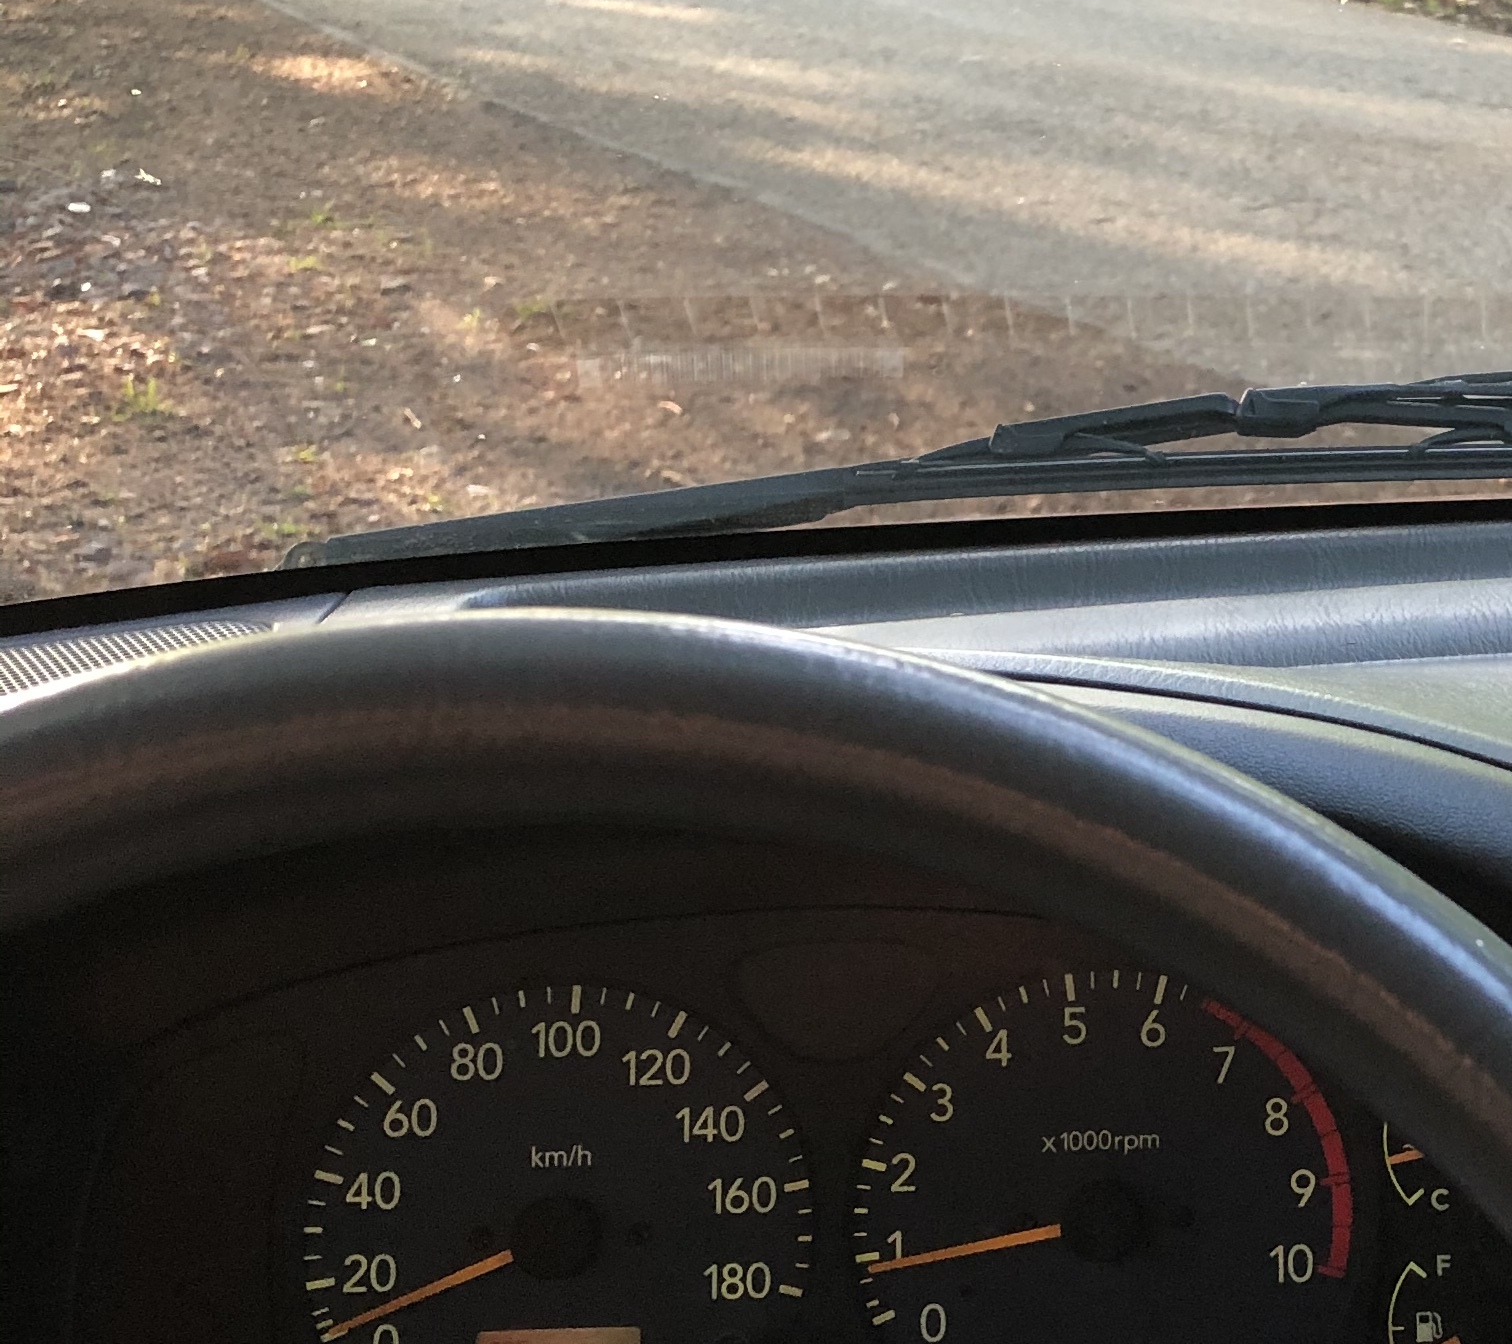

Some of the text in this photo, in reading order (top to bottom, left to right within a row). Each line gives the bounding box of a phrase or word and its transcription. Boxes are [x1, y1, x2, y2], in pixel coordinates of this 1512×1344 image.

[531, 1020, 601, 1058] 100
[1062, 1006, 1087, 1045] 5
[1140, 1009, 1166, 1047] 6
[450, 1042, 503, 1081] 80
[622, 1048, 691, 1086] 120
[985, 1029, 1012, 1067] 4
[1212, 1045, 1236, 1084] 7
[383, 1098, 438, 1138] 60
[930, 1083, 954, 1122] 3
[1264, 1097, 1289, 1136] 8
[675, 1105, 745, 1143] 140
[531, 1144, 592, 1168] km/h
[890, 1152, 916, 1193] 2
[345, 1171, 401, 1210] 40
[707, 1176, 777, 1214] 160
[1290, 1168, 1316, 1208] 9
[1430, 1188, 1450, 1211] C
[887, 1230, 902, 1262] 1
[1269, 1243, 1314, 1283] 10
[1436, 1254, 1451, 1277] F
[342, 1253, 397, 1293] 20
[703, 1261, 771, 1300] 180
[920, 1303, 947, 1343] 0
